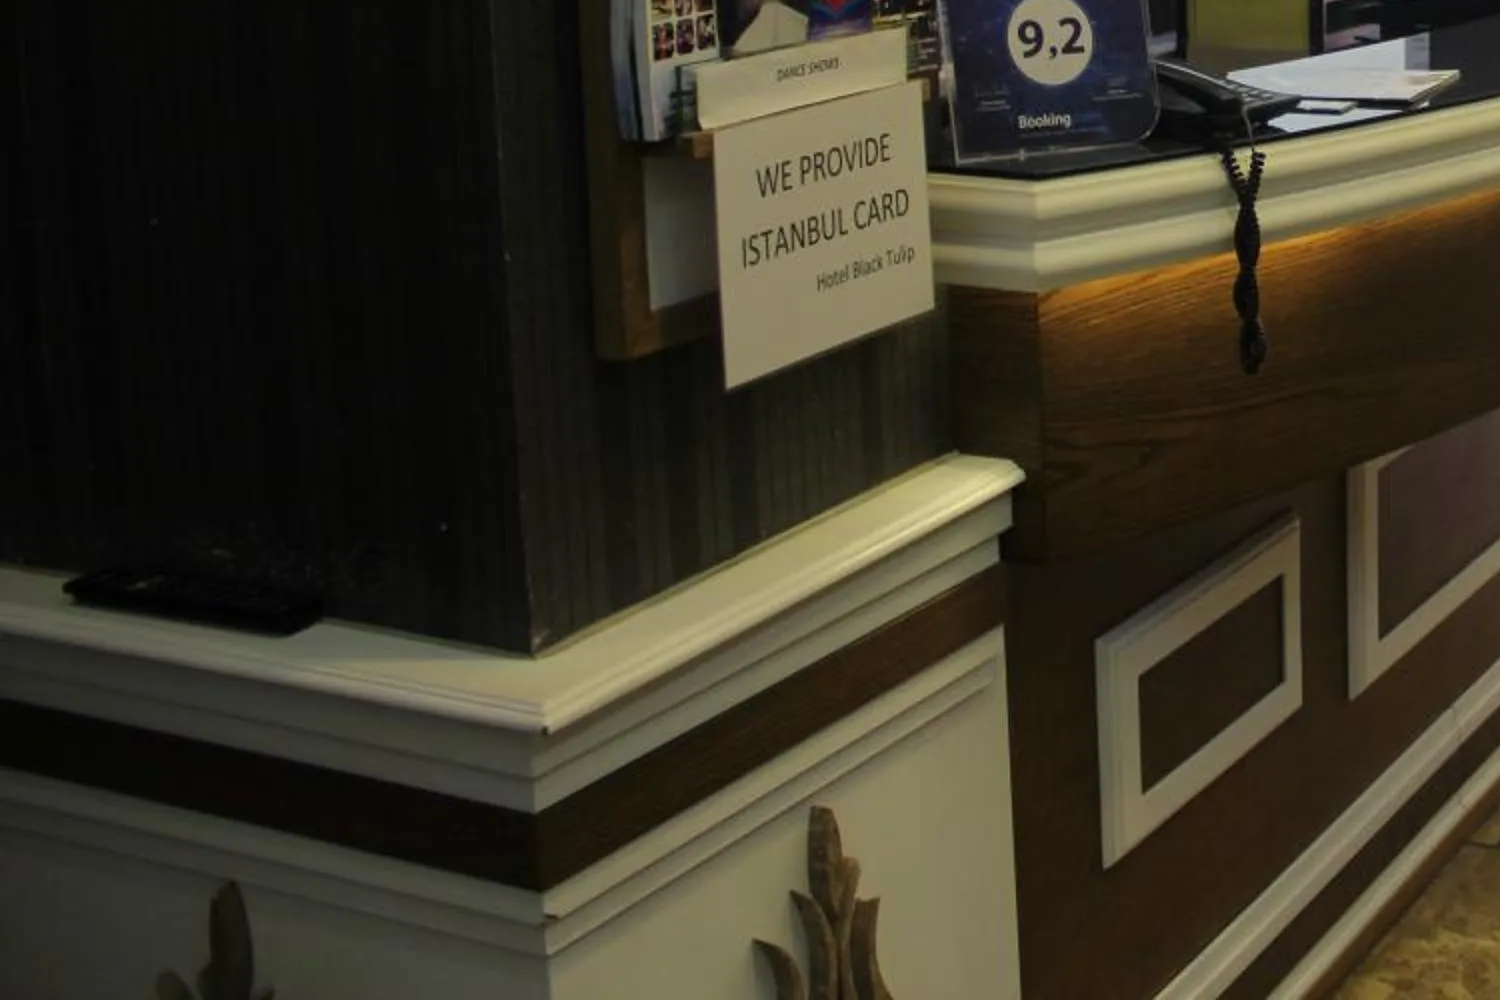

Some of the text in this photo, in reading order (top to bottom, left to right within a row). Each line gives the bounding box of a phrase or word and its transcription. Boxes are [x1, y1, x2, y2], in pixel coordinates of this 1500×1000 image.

[1016, 16, 1086, 59] 9,2
[776, 56, 840, 82] DANCE SHOWS
[756, 133, 891, 198] WE PROVIDE
[741, 189, 910, 269] ISTANBUL CARD
[816, 245, 916, 292] Hotel Black Tulip
